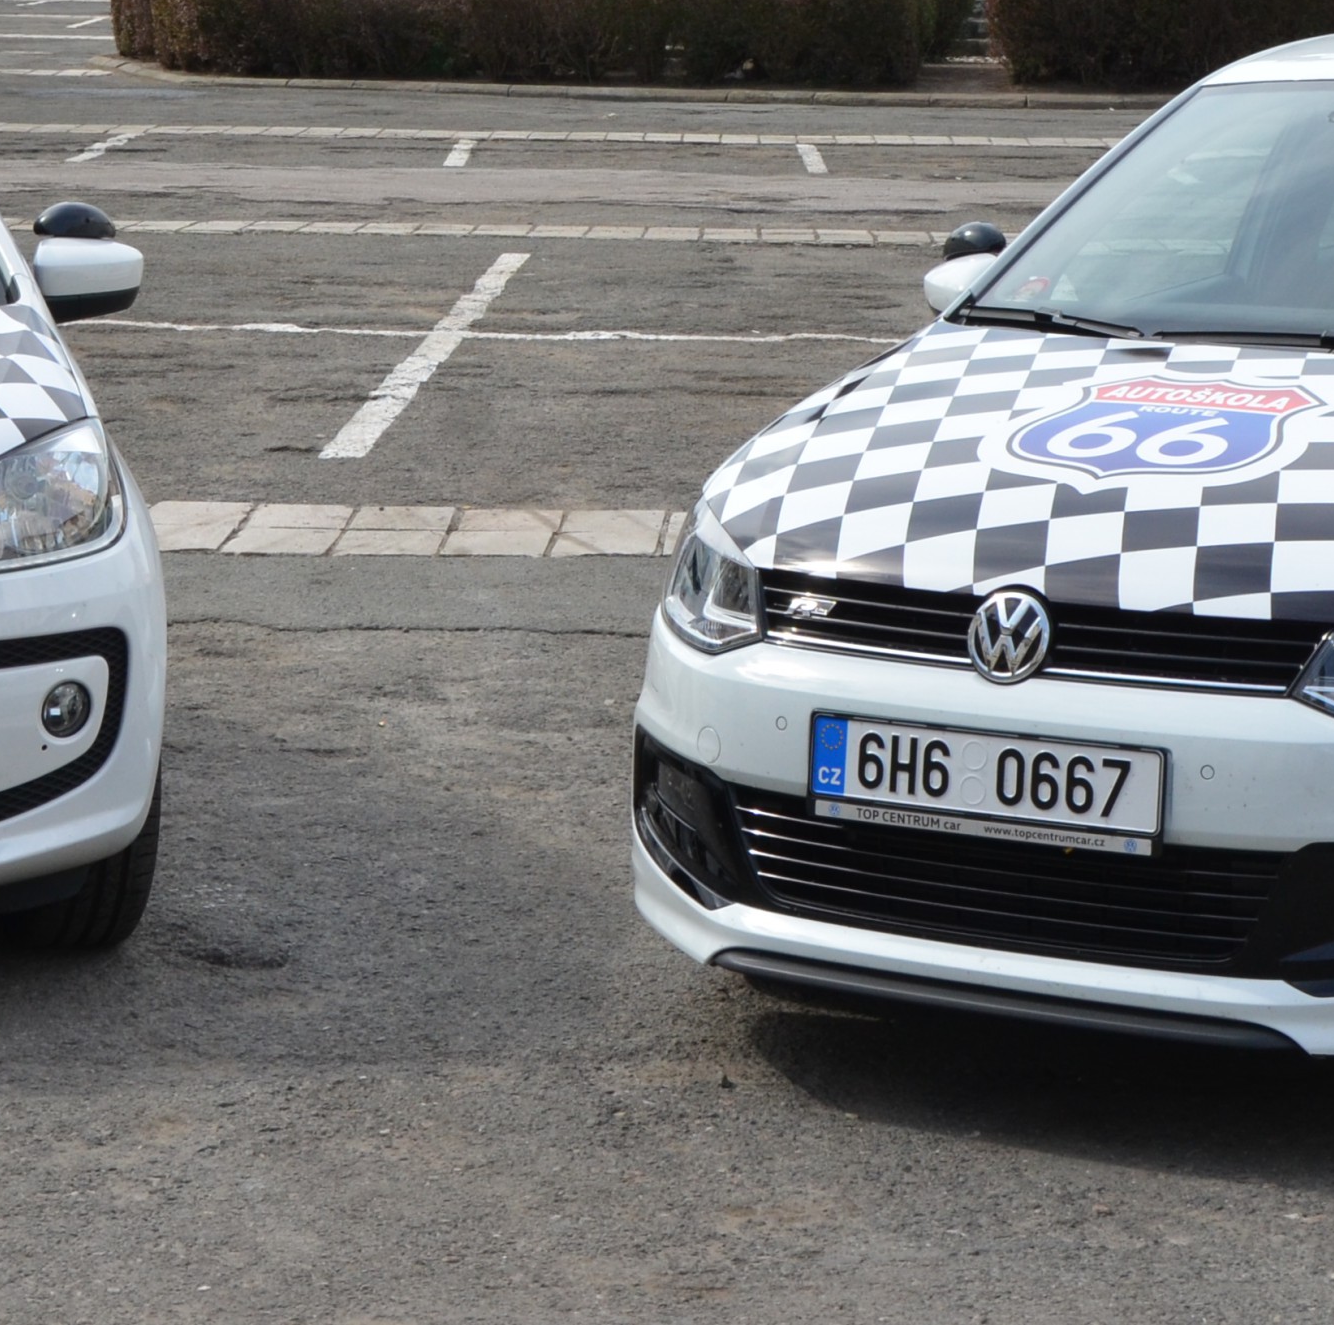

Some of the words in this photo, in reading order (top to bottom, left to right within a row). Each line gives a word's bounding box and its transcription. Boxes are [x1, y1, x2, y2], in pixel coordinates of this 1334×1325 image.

[1105, 387, 1292, 411] AUTOŠKOLA
[1137, 405, 1219, 417] ROUTE
[1046, 410, 1230, 465] 66
[818, 766, 841, 786] CZ
[857, 730, 951, 798] 6H6
[995, 747, 1132, 818] 0667
[856, 807, 880, 821] TOP
[882, 811, 941, 829] CENTRUM
[943, 821, 961, 832] car
[984, 825, 1106, 848] www.topcentrumcar.cz
